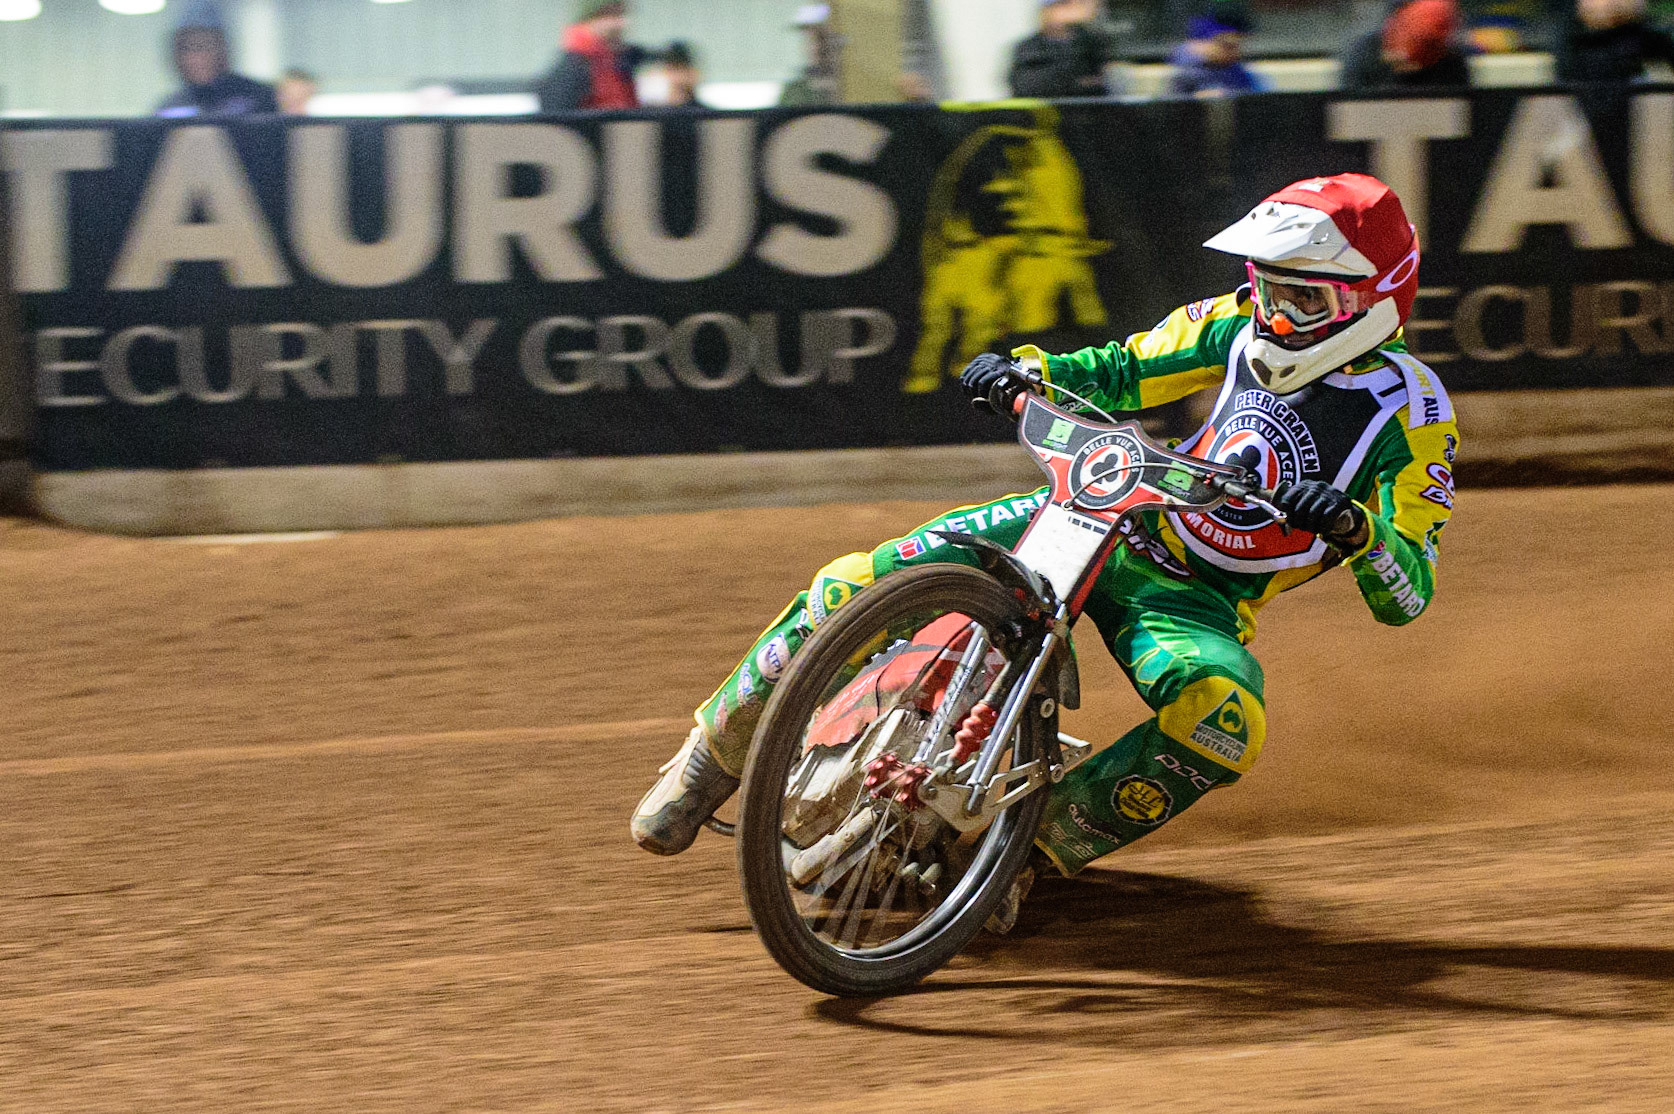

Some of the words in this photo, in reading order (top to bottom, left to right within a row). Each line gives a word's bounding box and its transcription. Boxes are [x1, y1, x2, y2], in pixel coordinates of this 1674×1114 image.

[0, 112, 898, 292] TAURUS
[36, 318, 500, 408] ECURITY
[518, 307, 898, 395] GROUP
[1083, 437, 1113, 456] BELLE
[1115, 436, 1133, 450] VUE
[1225, 418, 1257, 436] BELLE
[1259, 421, 1283, 446] VUE
[1235, 389, 1275, 412] PETER
[1271, 401, 1320, 473] CRAVEN
[1186, 511, 1256, 549] MORIAL
[1371, 551, 1426, 617] BETARD
